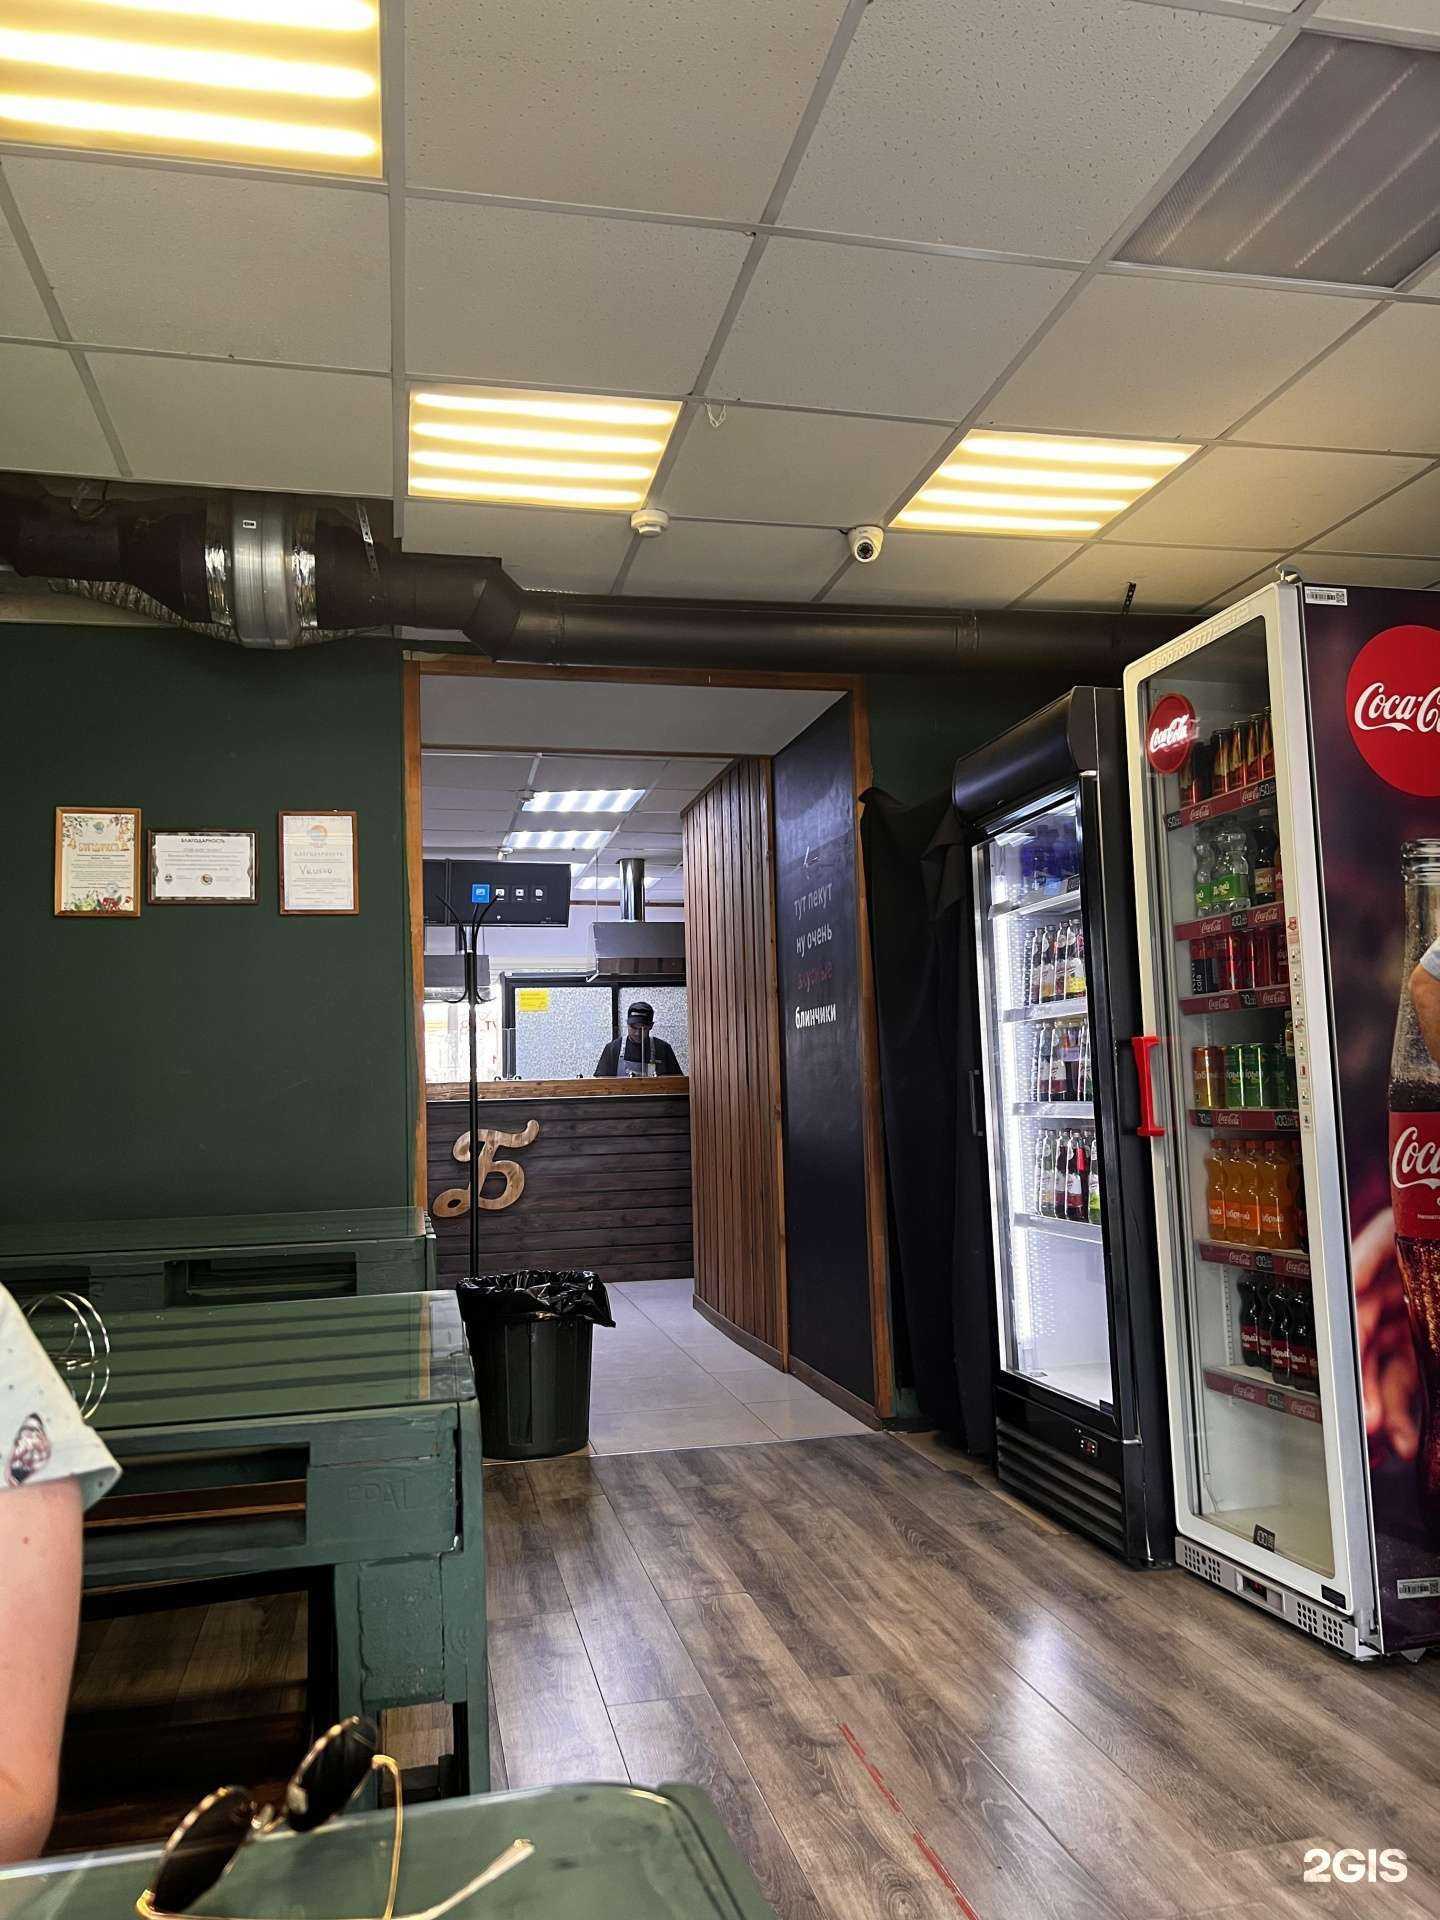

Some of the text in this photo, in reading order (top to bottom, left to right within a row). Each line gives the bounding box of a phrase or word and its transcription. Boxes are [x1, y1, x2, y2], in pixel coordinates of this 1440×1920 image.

[1150, 714, 1190, 753] Coca-Cola
[1190, 804, 1211, 820] Coca-Cola
[794, 883, 833, 920] тут пекут
[1255, 907, 1278, 923] Coca-Cola
[1201, 919, 1222, 934] Coca-Cola
[796, 923, 833, 958] ну очень
[795, 1003, 837, 1030] блинчики
